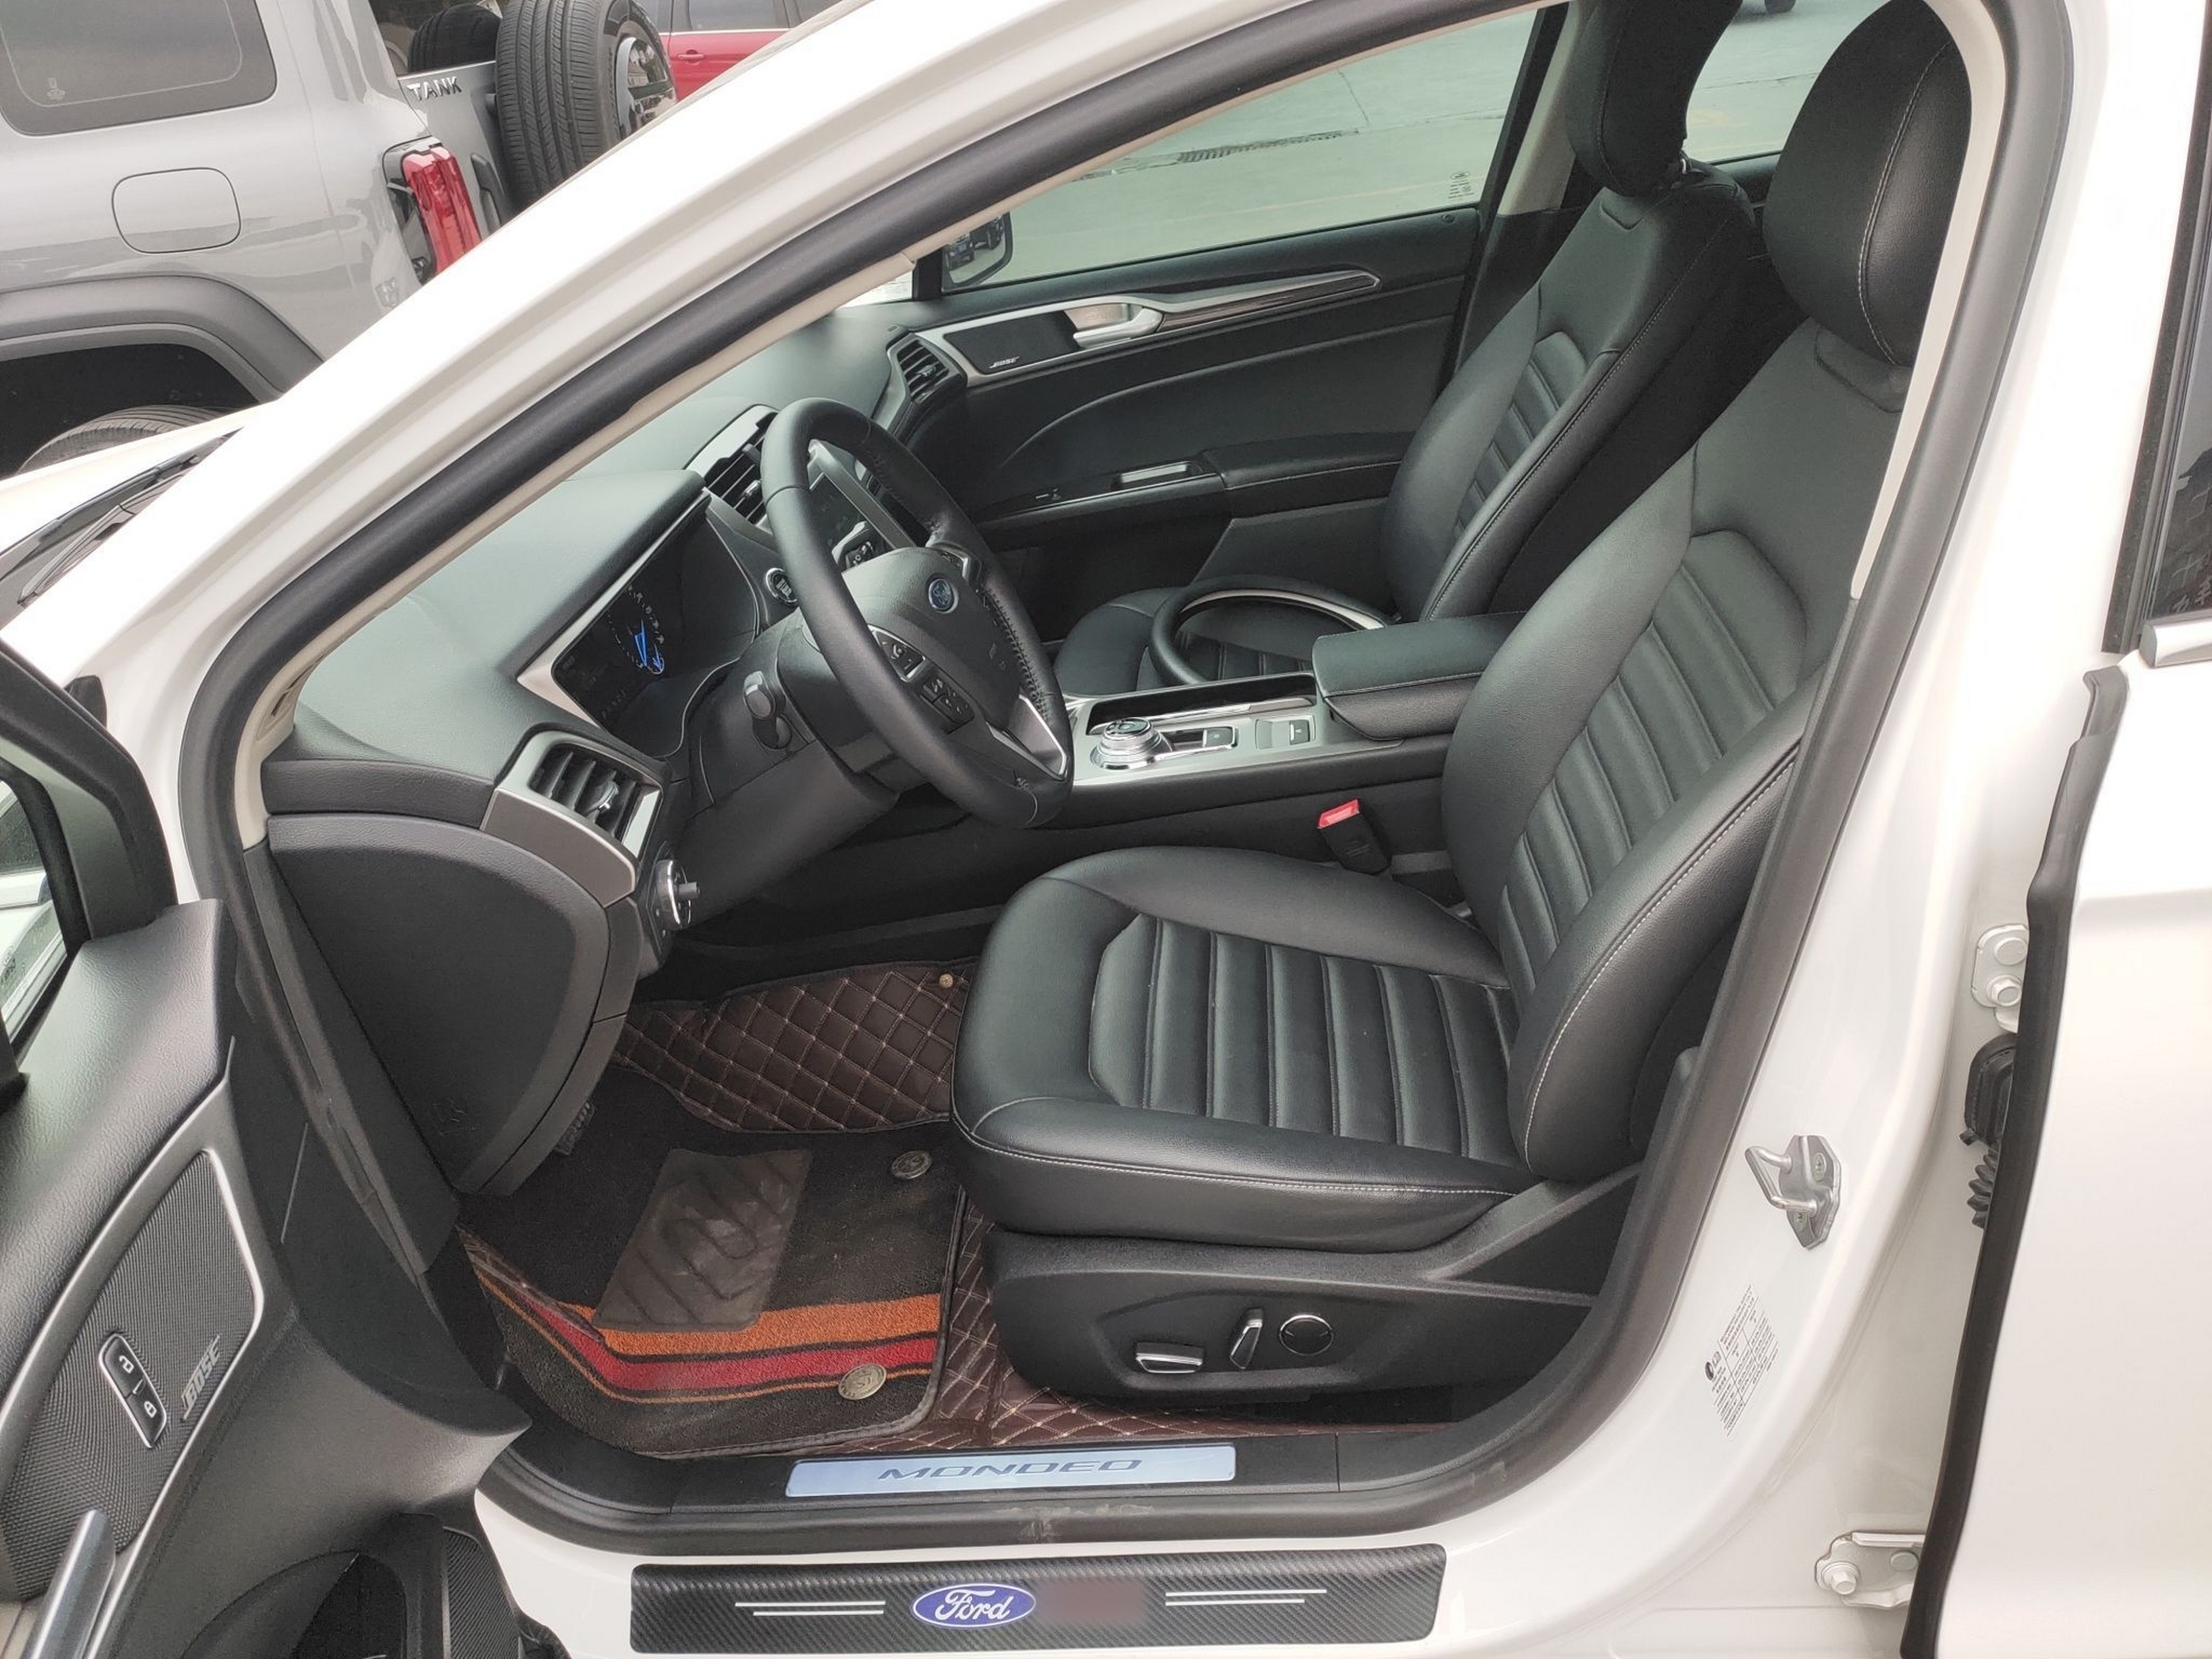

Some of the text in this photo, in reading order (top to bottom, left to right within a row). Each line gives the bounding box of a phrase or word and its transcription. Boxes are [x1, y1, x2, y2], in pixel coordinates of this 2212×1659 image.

[406, 76, 462, 101] TANK
[181, 1335, 220, 1419] BOSE
[878, 1459, 1142, 1479] MONDEO
[934, 1589, 1014, 1620] Ford
